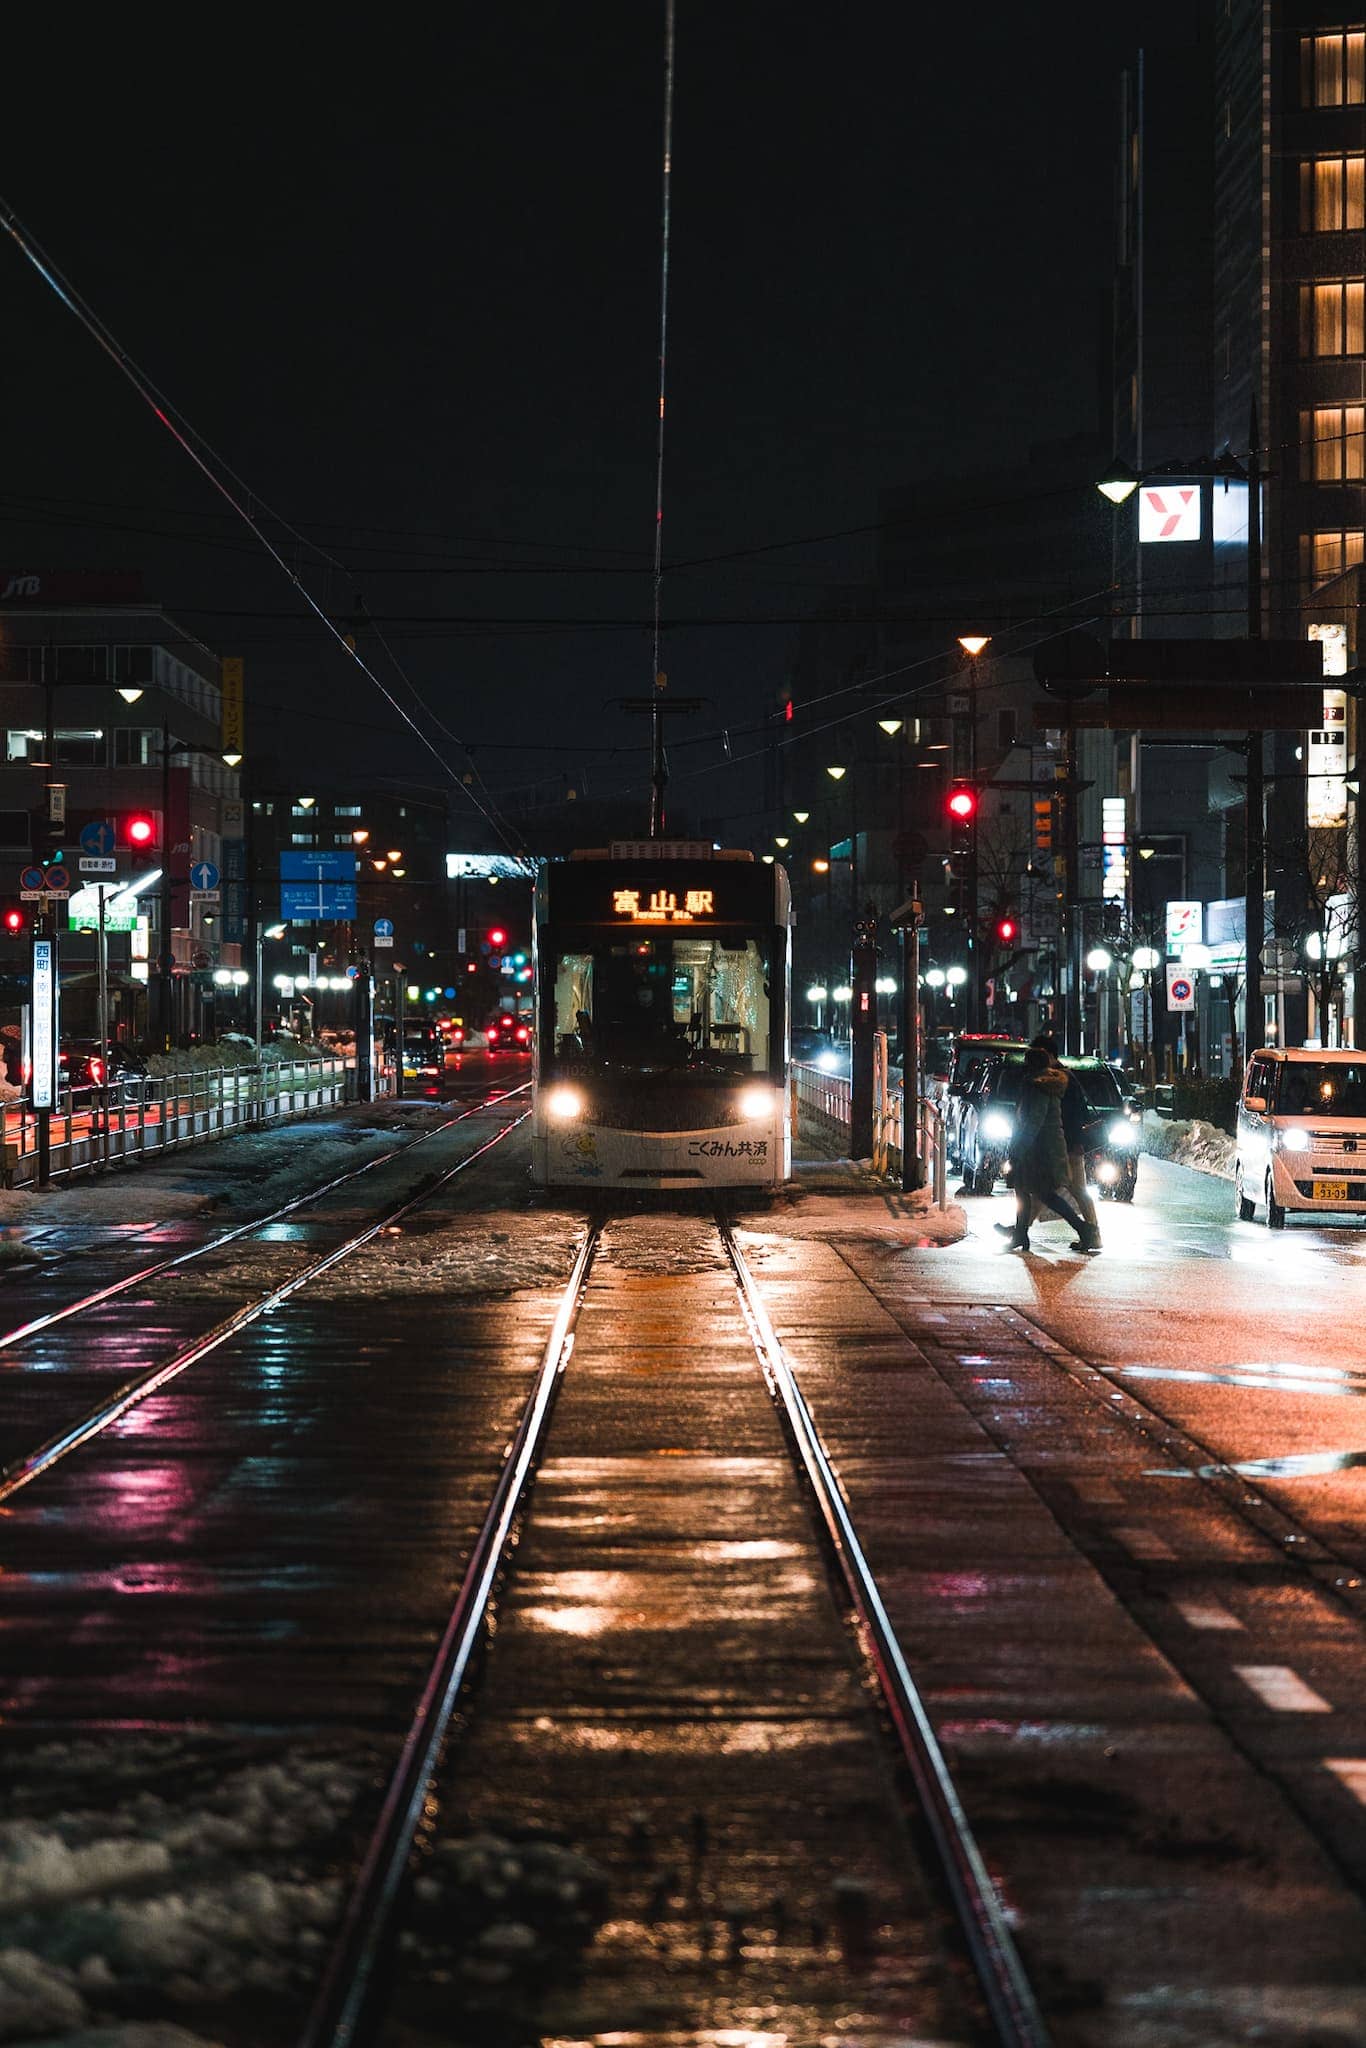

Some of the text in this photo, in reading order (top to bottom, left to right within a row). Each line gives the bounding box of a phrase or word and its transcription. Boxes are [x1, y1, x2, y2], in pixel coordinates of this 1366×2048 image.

[2, 575, 40, 599] JTB
[1319, 732, 1337, 744] 1F
[171, 843, 189, 854] JTB
[613, 889, 713, 913] 富山駅
[688, 1141, 768, 1157] こくみん共済
